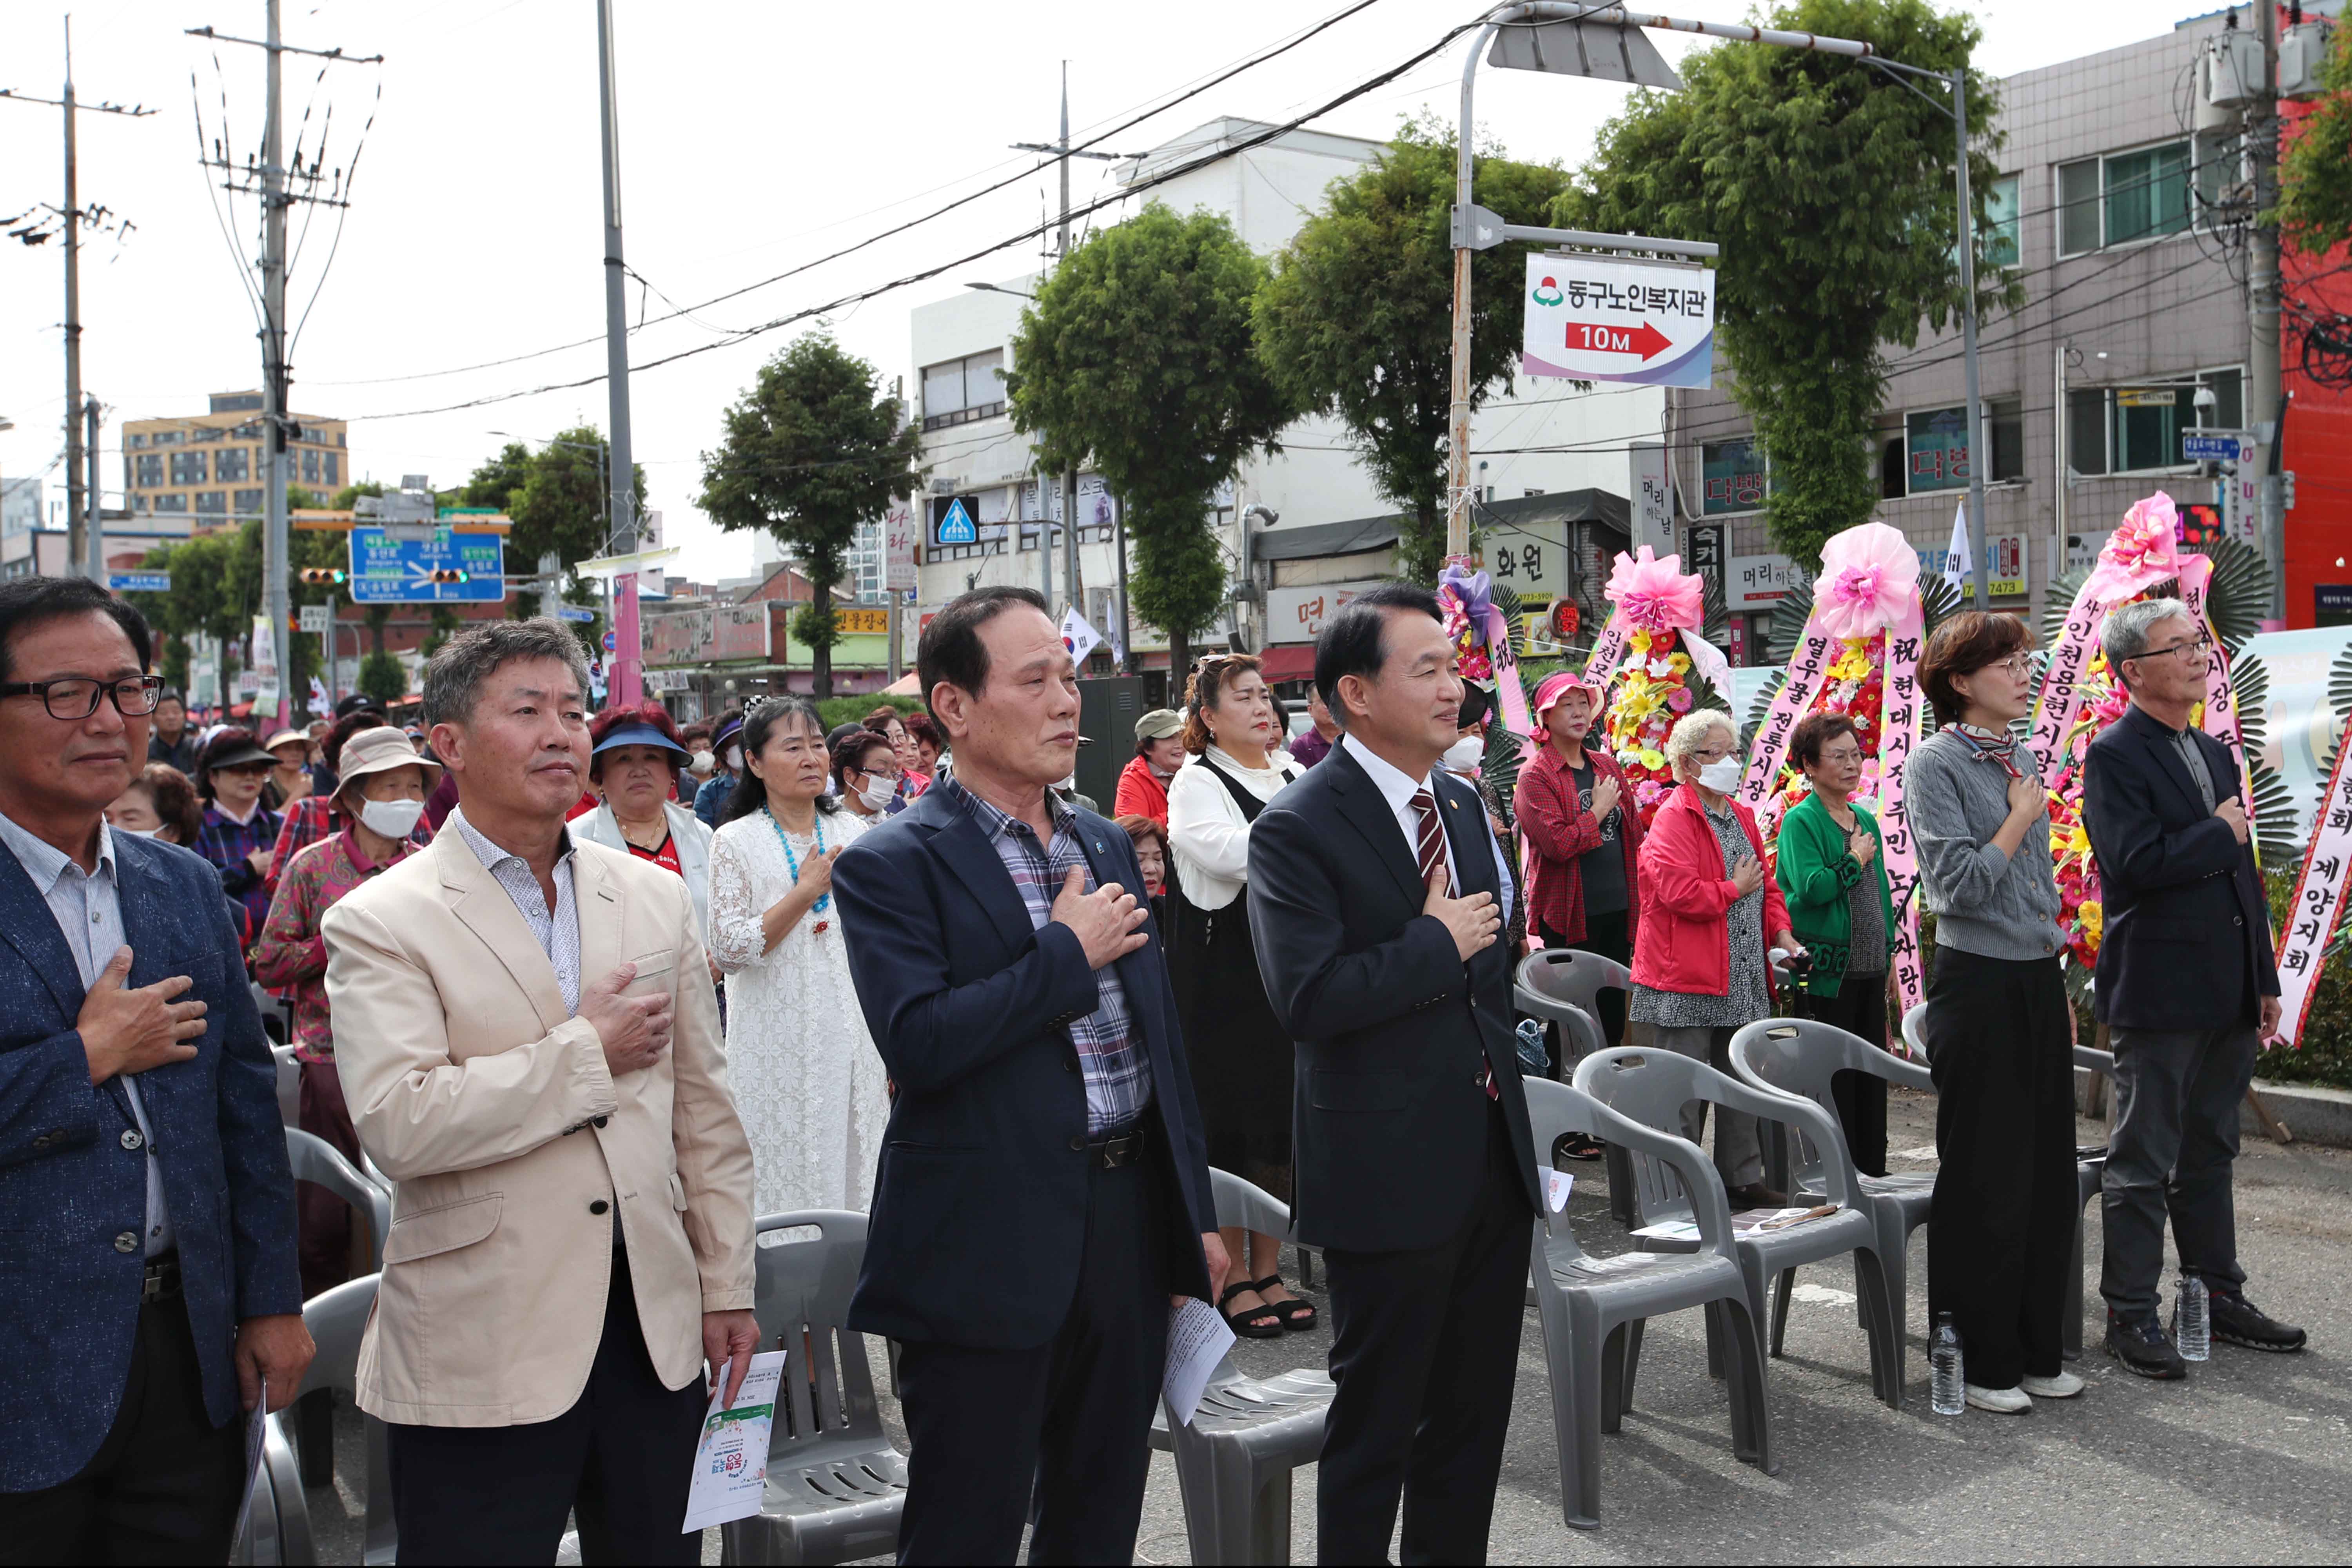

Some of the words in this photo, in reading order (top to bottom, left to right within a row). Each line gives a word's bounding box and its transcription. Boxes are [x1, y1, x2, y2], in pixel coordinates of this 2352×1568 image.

[1568, 279, 1707, 318] 동구노인복지관
[1580, 326, 1630, 351] 10M
[1912, 446, 1969, 480] 다방
[1644, 480, 1663, 507] 머리
[1706, 474, 1762, 505] 다방
[1647, 507, 1662, 520] 하는
[1661, 517, 1671, 535] 날
[1497, 544, 1543, 582] 화원
[1744, 563, 1771, 588] 머리
[1776, 570, 1796, 585] 하는
[1496, 638, 1514, 672] 祝
[1892, 637, 1919, 665] 祝
[1787, 637, 1828, 705] 열우물
[1745, 711, 1794, 802] 전통시장
[1884, 801, 1907, 855] 주민
[2283, 856, 2339, 978] 계양지회
